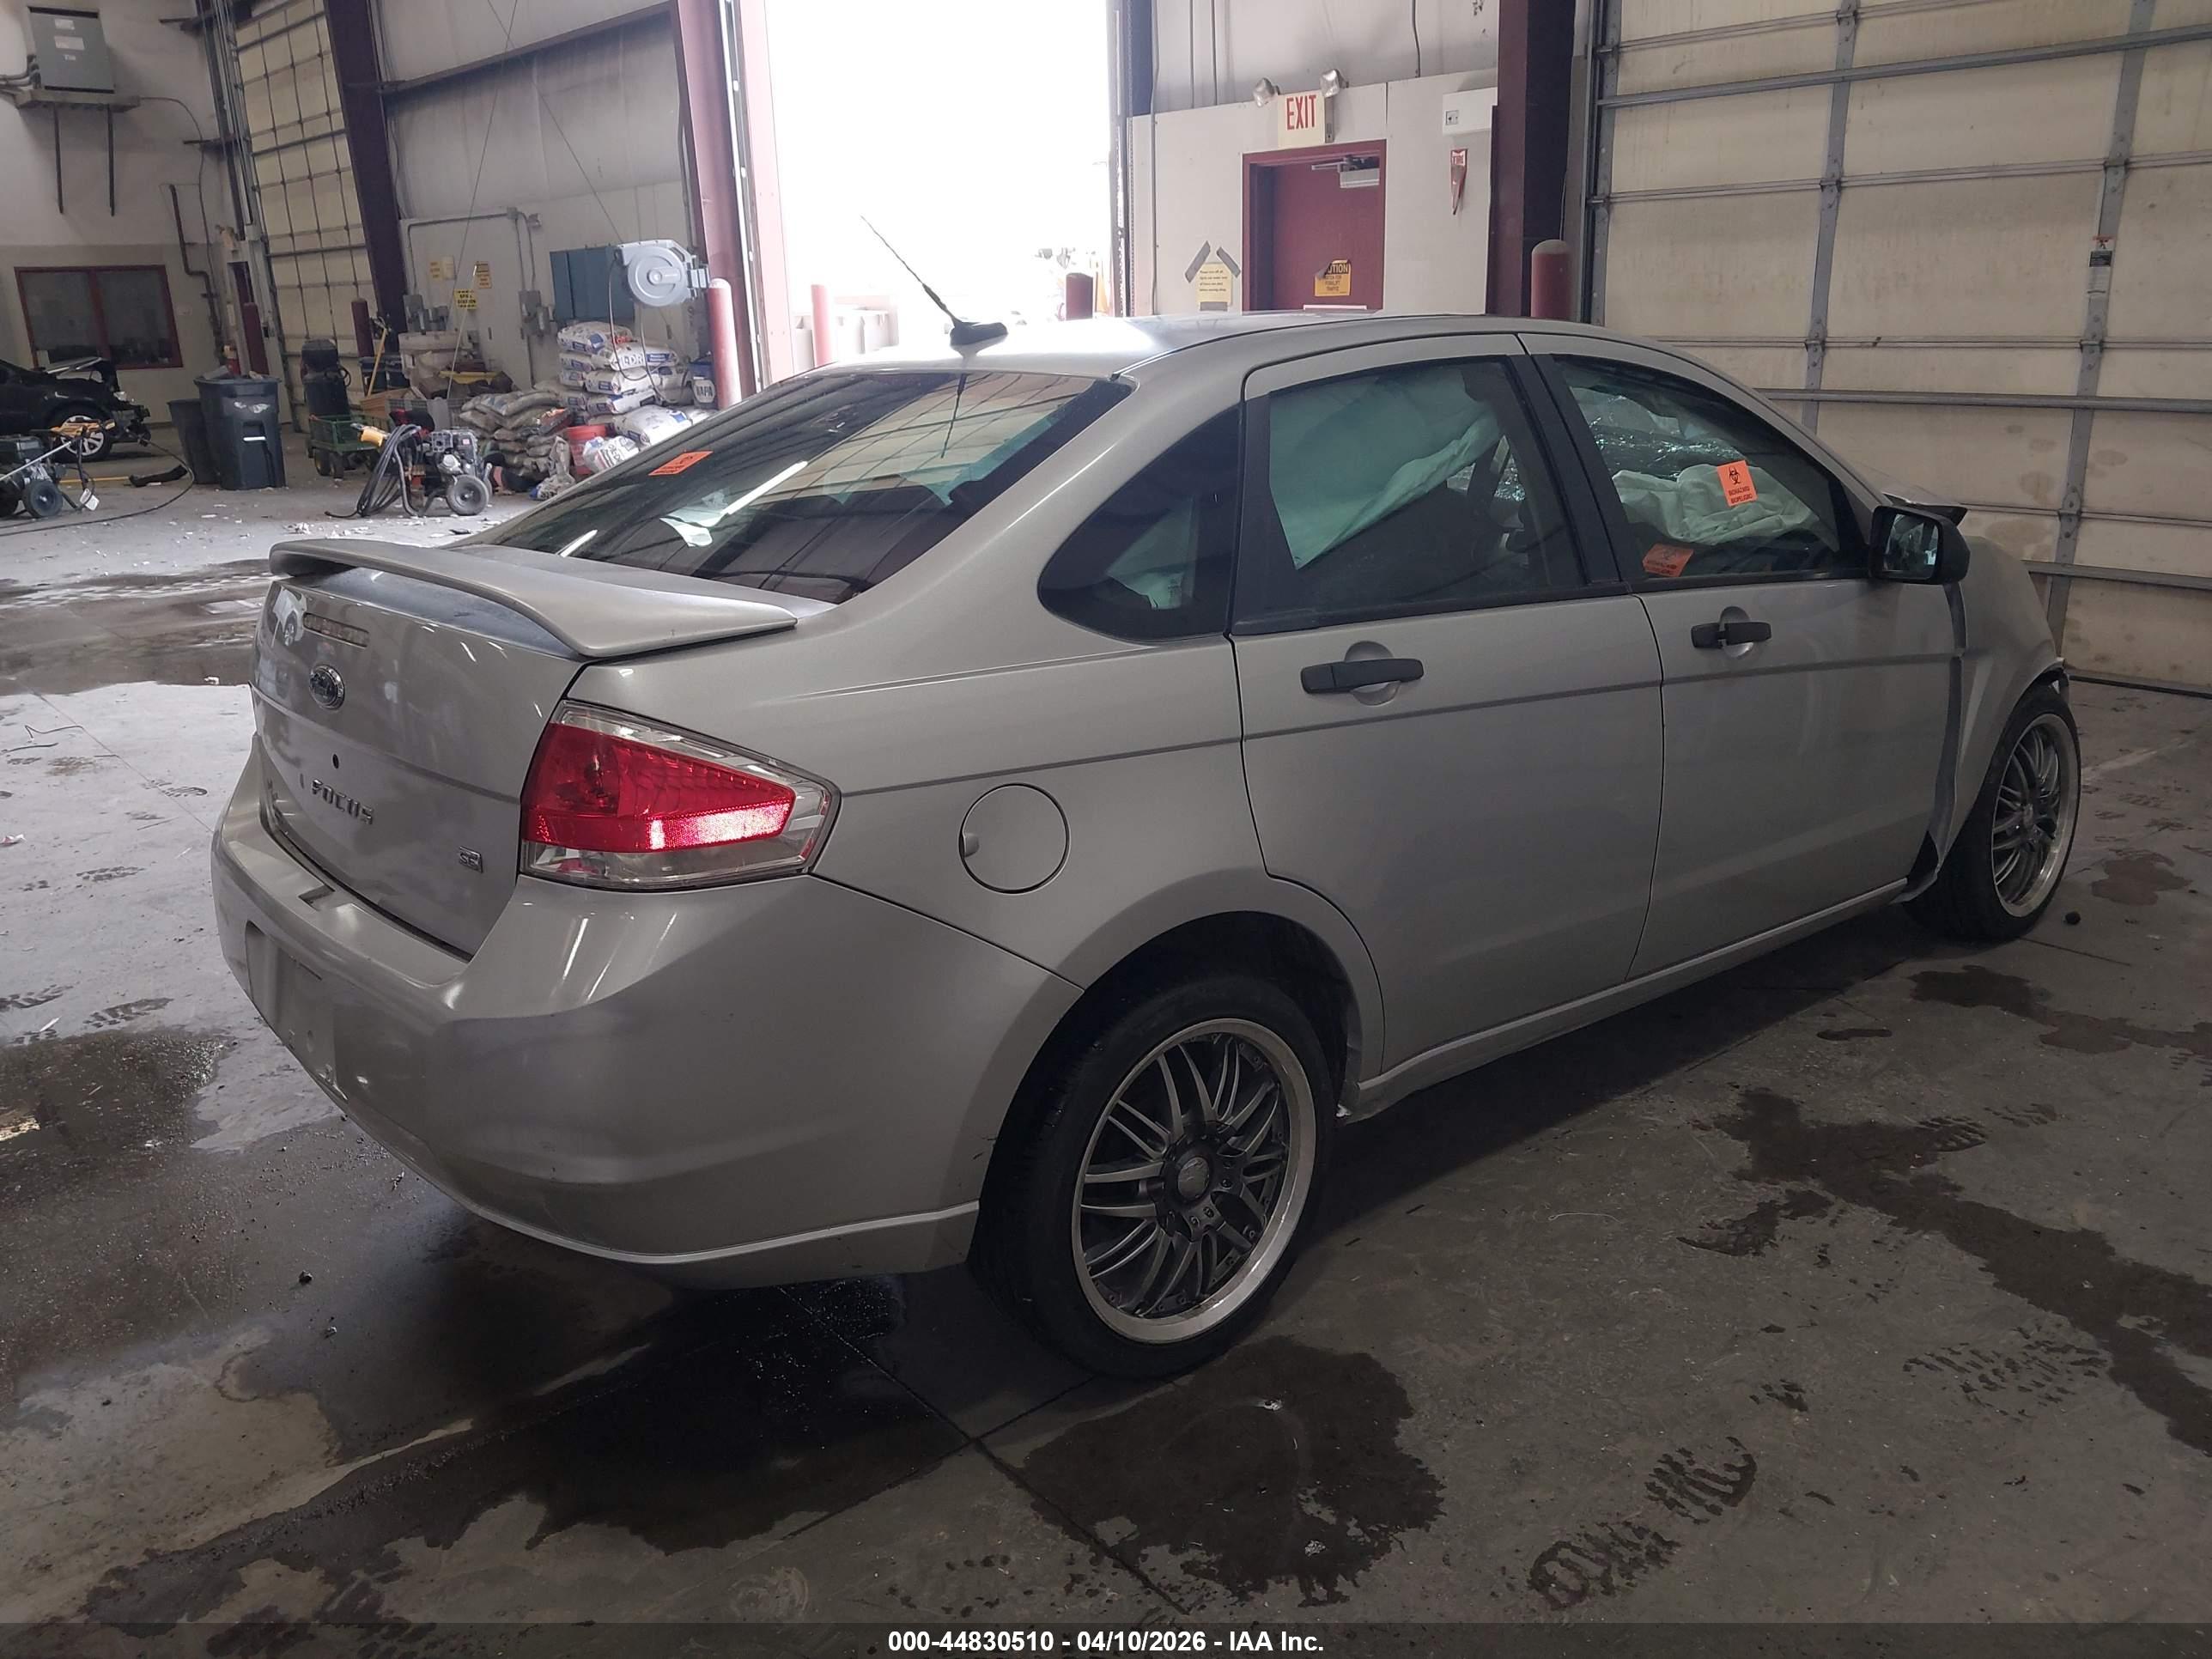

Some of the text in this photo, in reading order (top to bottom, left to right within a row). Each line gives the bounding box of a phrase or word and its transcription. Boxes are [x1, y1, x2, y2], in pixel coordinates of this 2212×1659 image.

[1286, 94, 1316, 130] EXIT
[1328, 263, 1348, 274] UTION
[1728, 485, 1750, 496] BIOHAZARD
[312, 778, 374, 825] FOCUS
